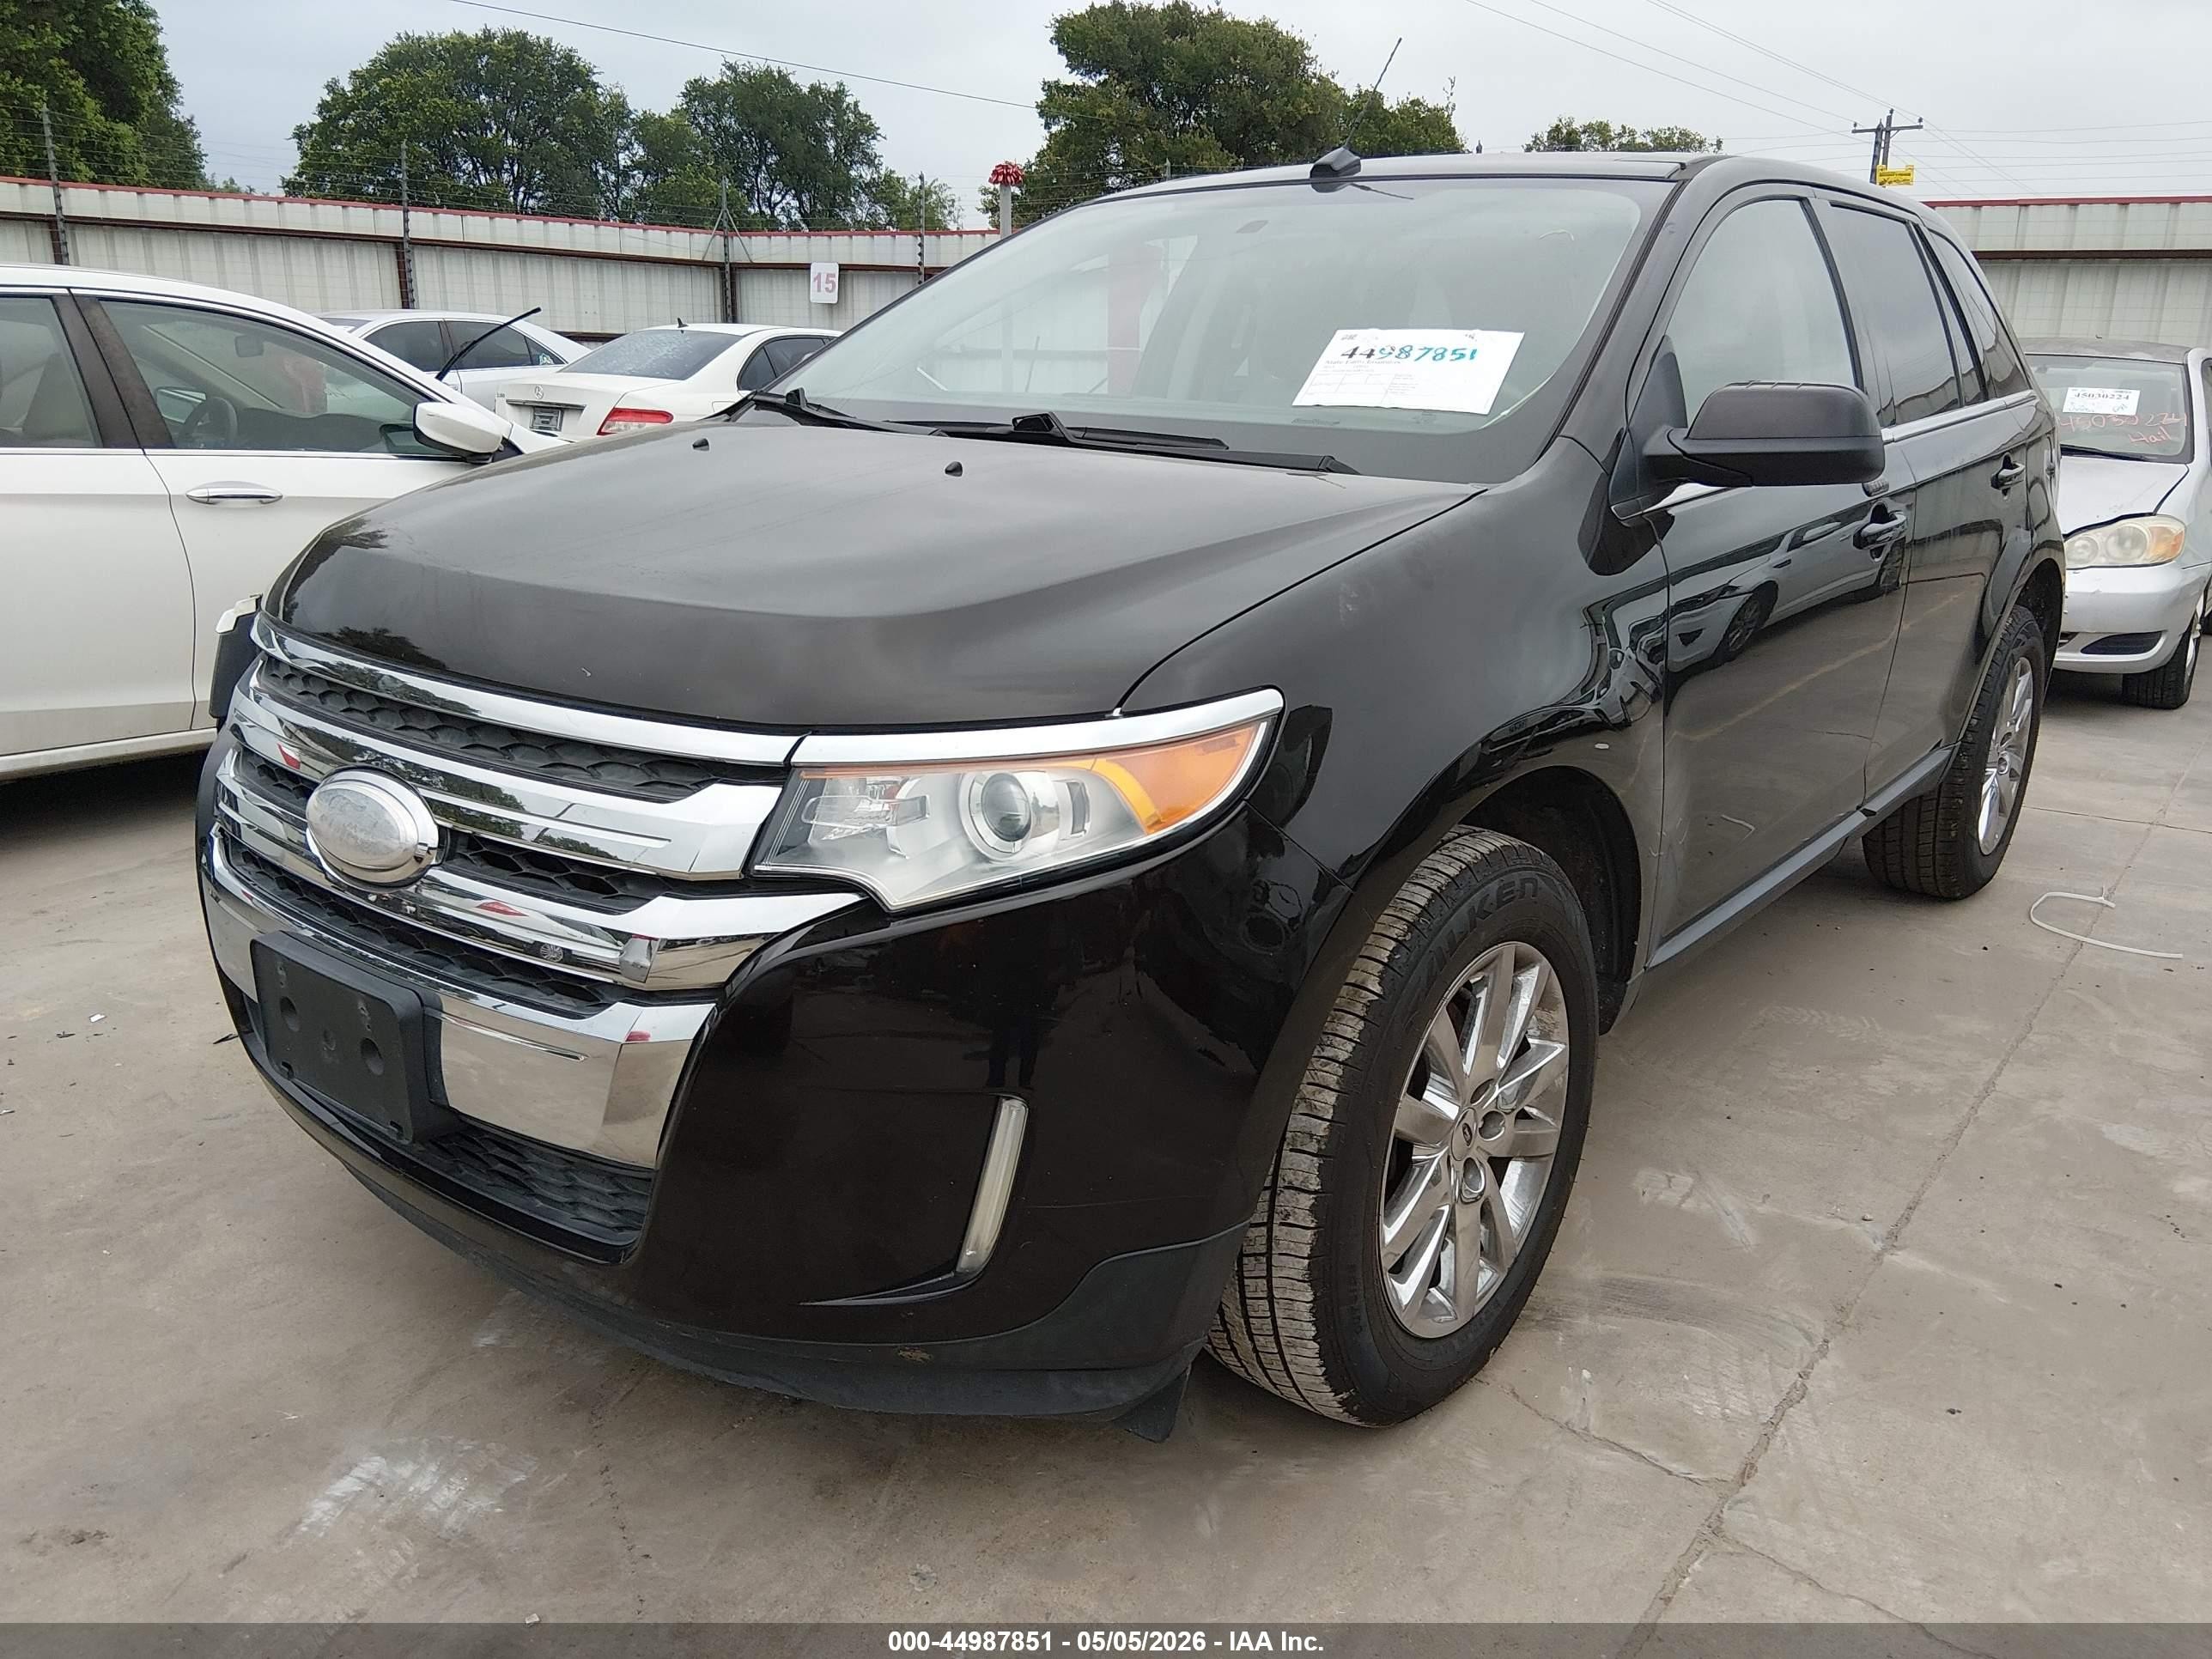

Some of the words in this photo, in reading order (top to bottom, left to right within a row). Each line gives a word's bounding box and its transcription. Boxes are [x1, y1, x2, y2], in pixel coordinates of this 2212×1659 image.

[813, 272, 836, 294] 15
[1340, 345, 1478, 362] 44987851
[2129, 426, 2172, 444] Hail
[1414, 876, 1539, 1003] ALKEN
